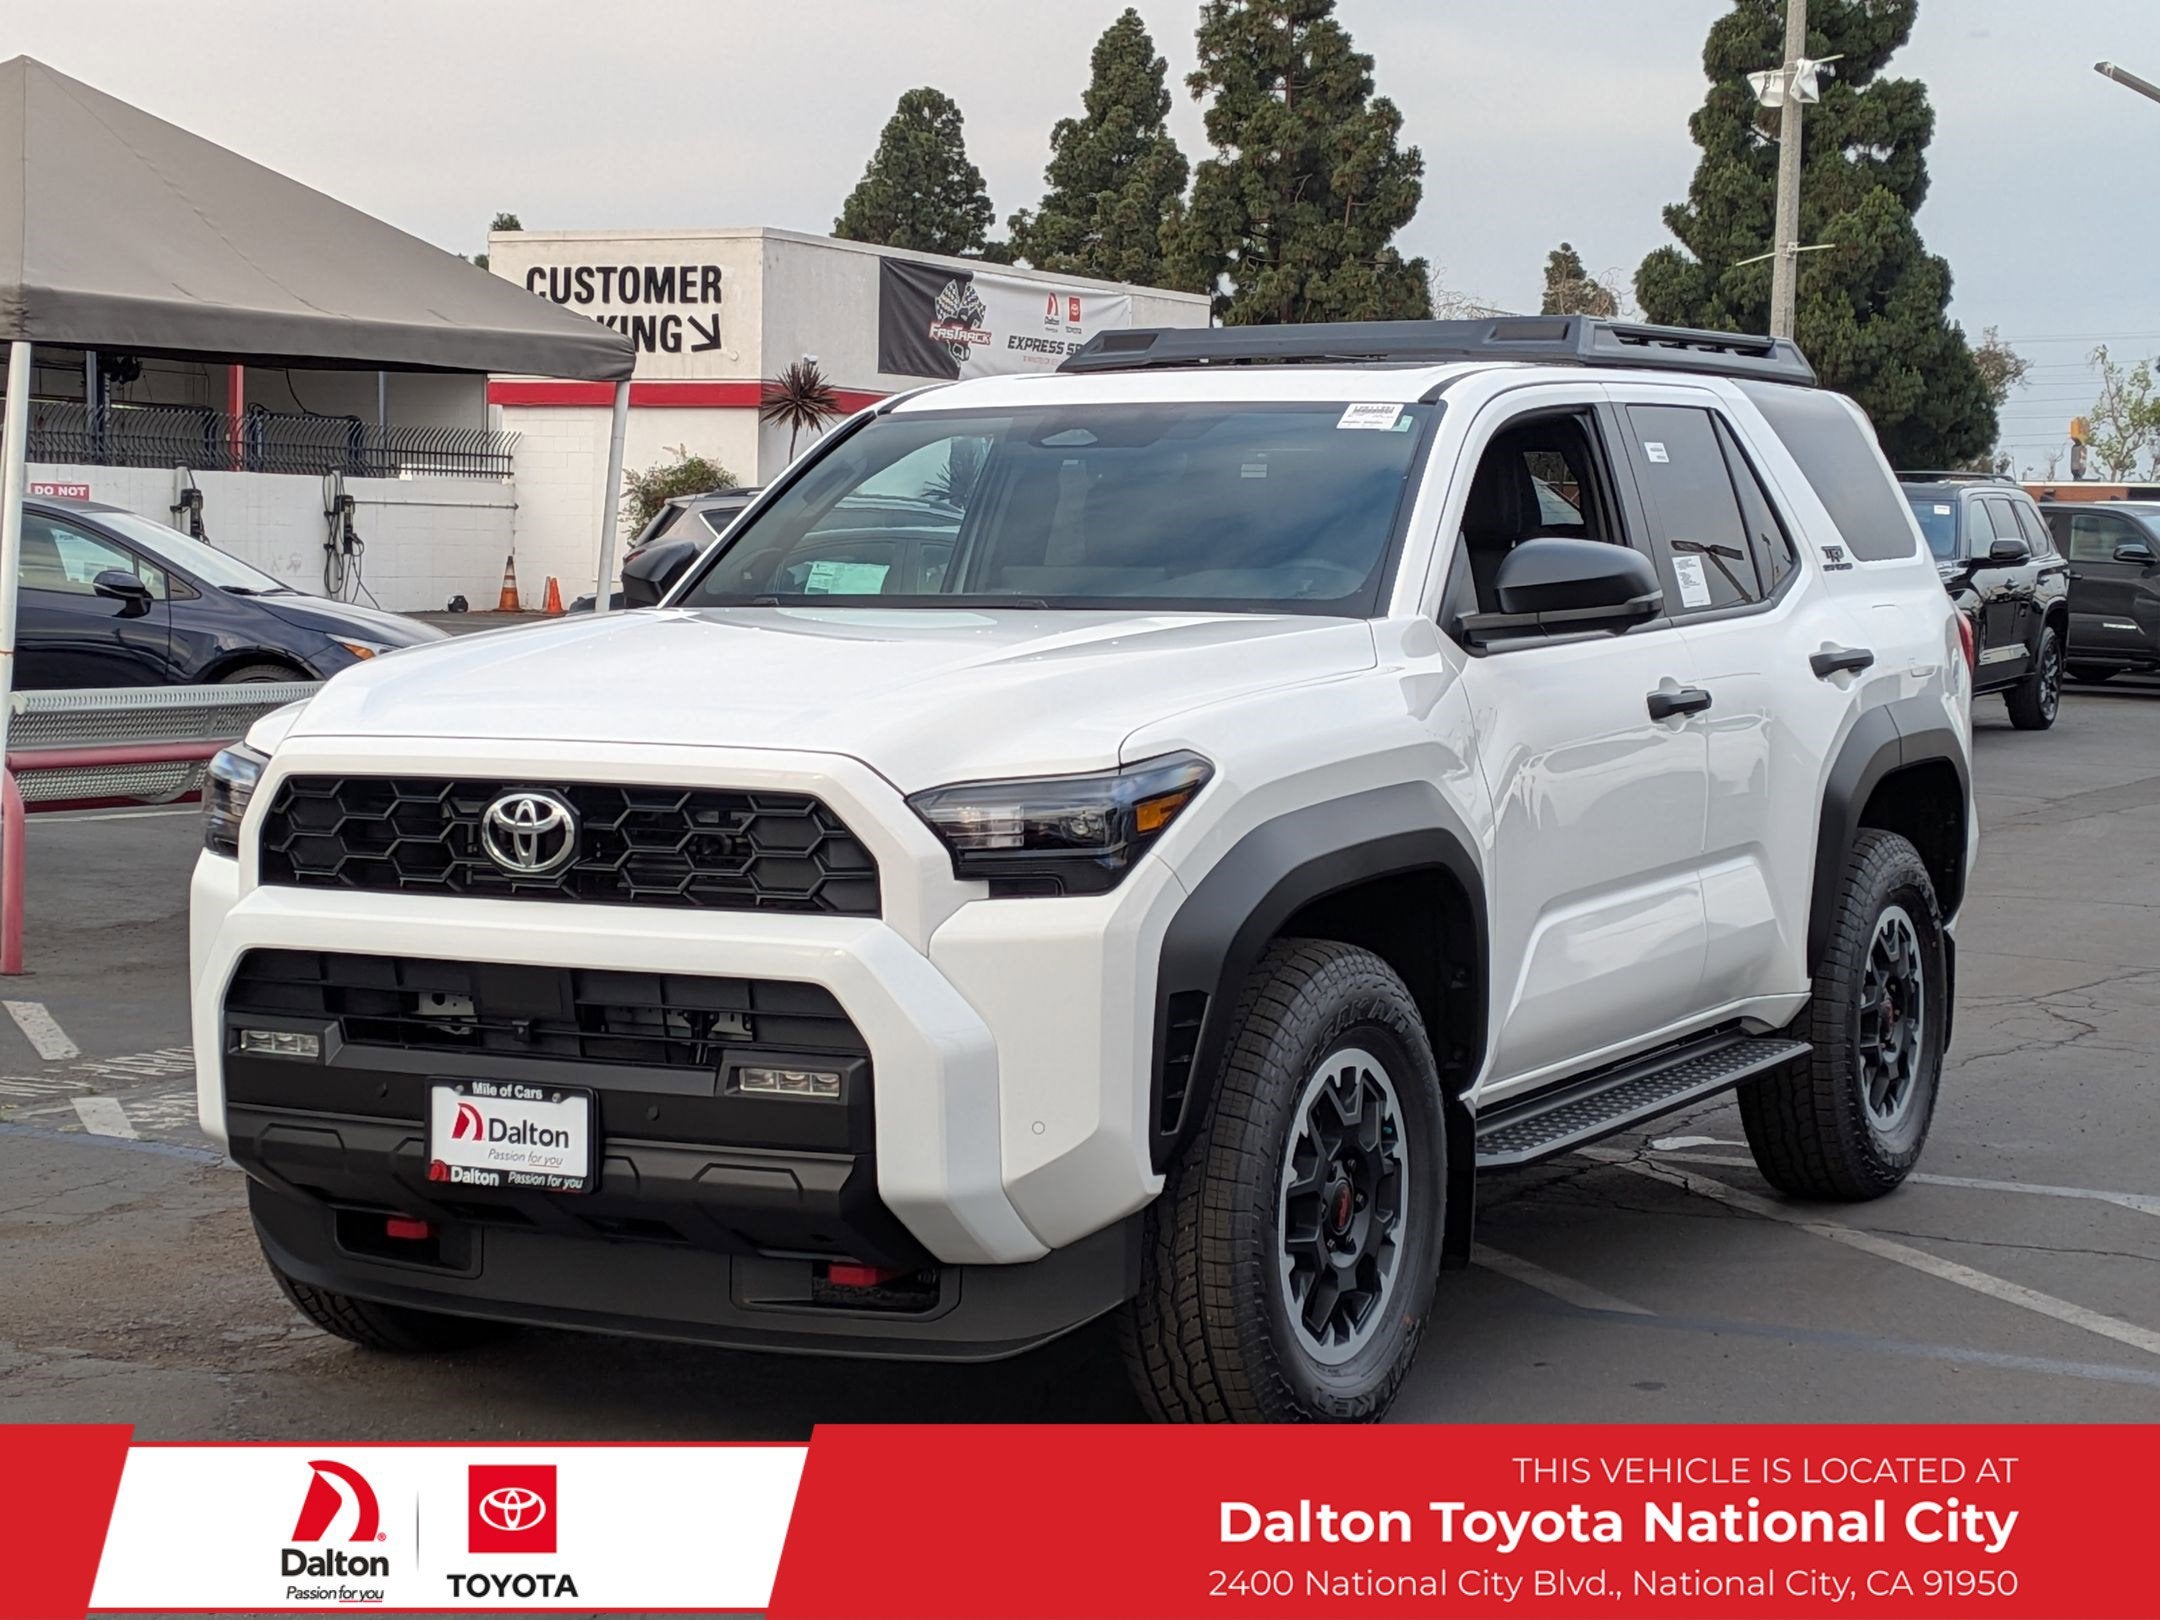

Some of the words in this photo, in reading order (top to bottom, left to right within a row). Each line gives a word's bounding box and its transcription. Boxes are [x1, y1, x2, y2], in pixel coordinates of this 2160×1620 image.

[526, 265, 722, 304] CUSTOMER
[1007, 335, 1065, 355] EXPRESS
[34, 486, 54, 495] DO
[58, 486, 86, 496] NOT
[472, 1081, 497, 1096] Mile
[500, 1083, 513, 1097] of
[514, 1085, 543, 1100] Cars
[488, 1118, 569, 1148] Dalton
[488, 1148, 526, 1162] Passion
[527, 1151, 542, 1165] for
[543, 1155, 563, 1167] you
[451, 1166, 500, 1187] Dalton
[508, 1171, 546, 1186] Passion
[546, 1174, 562, 1188] for
[562, 1178, 583, 1190] you
